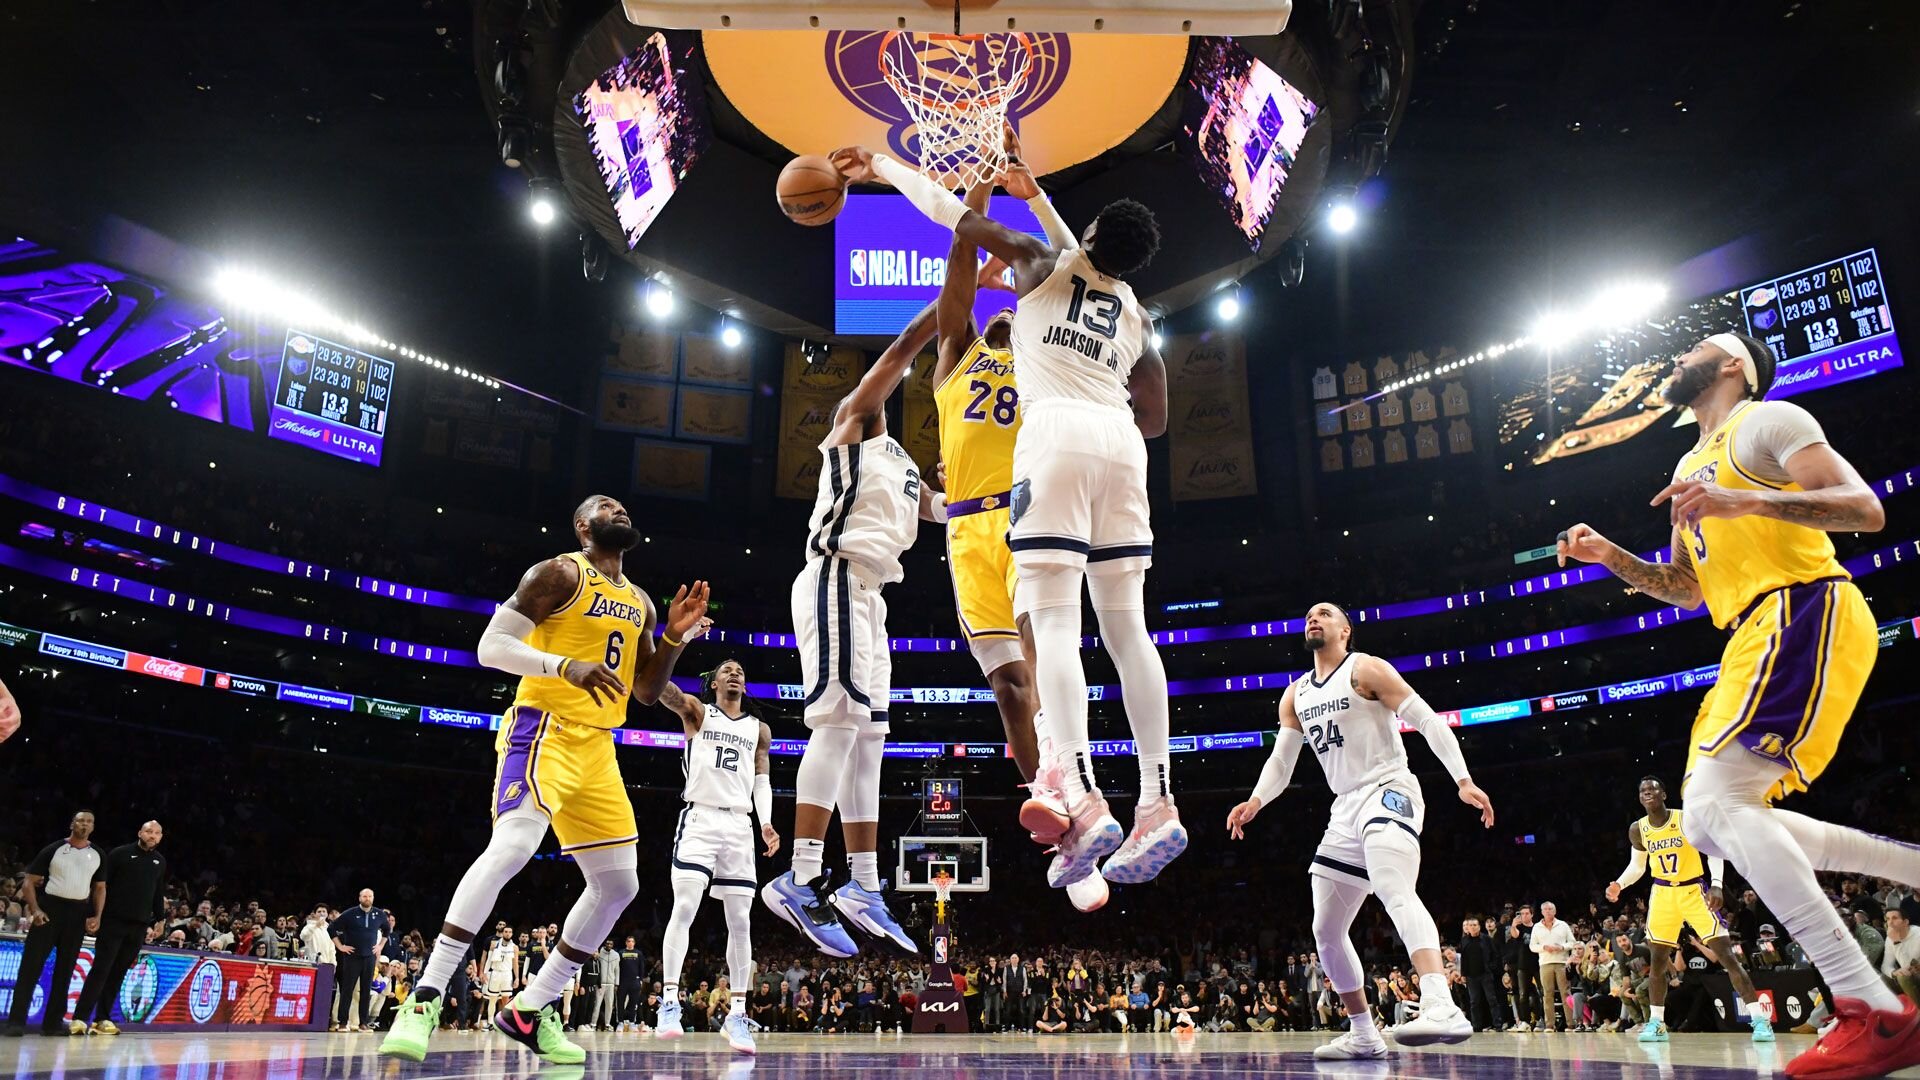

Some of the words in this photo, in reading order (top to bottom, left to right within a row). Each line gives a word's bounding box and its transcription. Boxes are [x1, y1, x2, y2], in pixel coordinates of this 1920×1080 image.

[868, 250, 908, 286] NBA
[1780, 282, 1795, 299] 29
[1796, 277, 1811, 294] 25
[1812, 272, 1827, 288] 27
[1830, 267, 1844, 284] 21
[1850, 257, 1873, 277] 102
[1066, 273, 1122, 340] 13
[1785, 304, 1800, 321] 23
[1800, 298, 1816, 316] 29
[1818, 294, 1831, 311] 31
[1836, 288, 1851, 305] 19
[1855, 280, 1878, 300] 102
[1803, 317, 1839, 344] 13.3
[1042, 325, 1103, 362] JACKSON
[317, 346, 330, 362] 29
[344, 354, 356, 370] 27
[357, 359, 368, 374] 21
[374, 364, 390, 382] 102
[964, 352, 1016, 376] LAKE
[1833, 346, 1894, 371] ULTRA
[314, 366, 326, 382] 23
[326, 371, 339, 386] 29
[340, 374, 351, 390] 31
[356, 379, 366, 394] 19
[370, 384, 386, 402] 102
[322, 391, 349, 414] 13.3
[964, 379, 1019, 426] 28
[332, 434, 376, 455] ULTRA
[1884, 472, 1914, 494] GE
[57, 496, 107, 522] GET
[135, 520, 216, 555] LOUD!
[288, 560, 330, 582] GET
[356, 576, 428, 603] LOUD!
[1446, 591, 1485, 609] GET
[1510, 570, 1584, 596] LOUD!
[71, 567, 121, 592] GET
[150, 588, 230, 622] LOUD!
[583, 591, 642, 628] LAKERS
[1638, 607, 1682, 630] GET
[1251, 621, 1288, 636] GET
[48, 644, 72, 656] Happy
[90, 652, 119, 666] Birthday
[304, 624, 348, 644] GET
[374, 636, 448, 663] LOUD!
[604, 630, 624, 670] 6
[1425, 651, 1466, 668] GET
[1490, 632, 1564, 658] LOUD!
[232, 679, 266, 692] TOYOTA
[1225, 675, 1264, 690] GET
[1608, 680, 1665, 700] Spectrum
[284, 689, 318, 700] AMERICAN
[319, 695, 348, 705] EXPRESS
[920, 690, 950, 702] 13.3
[960, 693, 966, 701] 4
[974, 692, 996, 700] Grizz
[1555, 694, 1588, 706] TOYOTA
[428, 708, 482, 727] Spectrum
[1298, 698, 1350, 723] MEMPHIS
[702, 730, 754, 752] MEMPHIS
[1089, 744, 1129, 752] DELTA
[1214, 736, 1254, 745] crypto.com
[1309, 719, 1344, 754] 24
[716, 746, 740, 772] 12
[932, 782, 952, 794] 13.1
[931, 793, 951, 811] 2.0
[1647, 836, 1684, 853] LAKERS
[1658, 853, 1678, 874] 17
[921, 1001, 960, 1012] KIA
[1787, 1004, 1801, 1012] TNT
